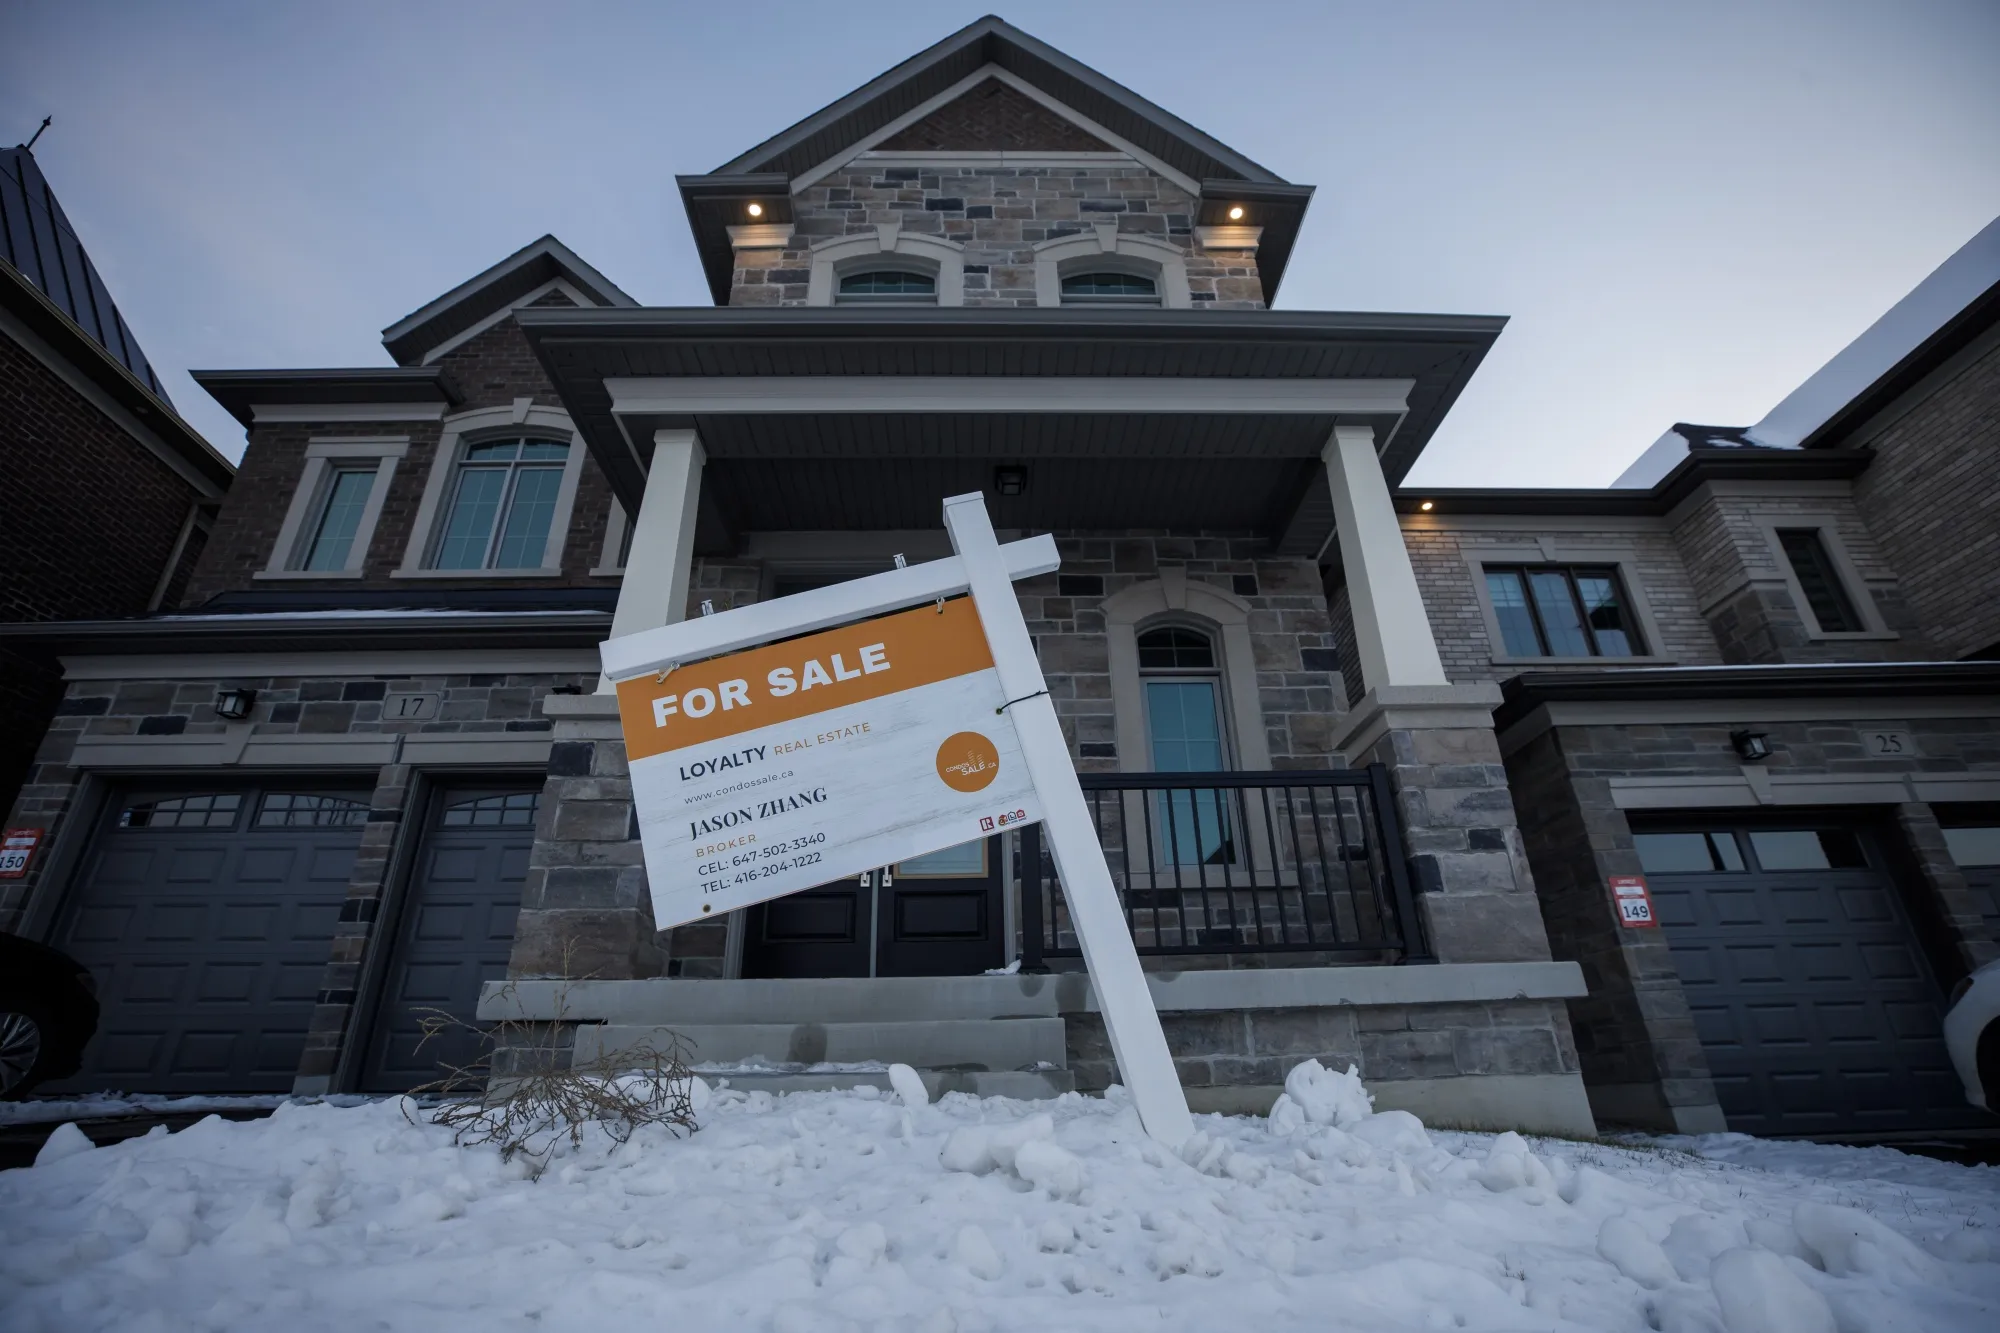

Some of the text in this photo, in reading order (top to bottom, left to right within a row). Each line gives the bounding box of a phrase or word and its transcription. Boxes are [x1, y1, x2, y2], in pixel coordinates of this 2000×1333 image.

[652, 642, 891, 728] FOR SALE
[399, 698, 424, 716] 17
[679, 722, 871, 781] LOYALTY REAL ESTATE
[1876, 734, 1902, 752] 25
[961, 762, 985, 775] SALE
[683, 769, 794, 805] www.condossale.ca
[689, 787, 827, 841] JASON ZHANG
[696, 833, 757, 858] BROKER
[698, 832, 826, 876] CEL: 647-502-3340
[0, 856, 25, 868] 150
[701, 851, 822, 894] TEL: 416-204-1222
[1623, 905, 1649, 918] 149
